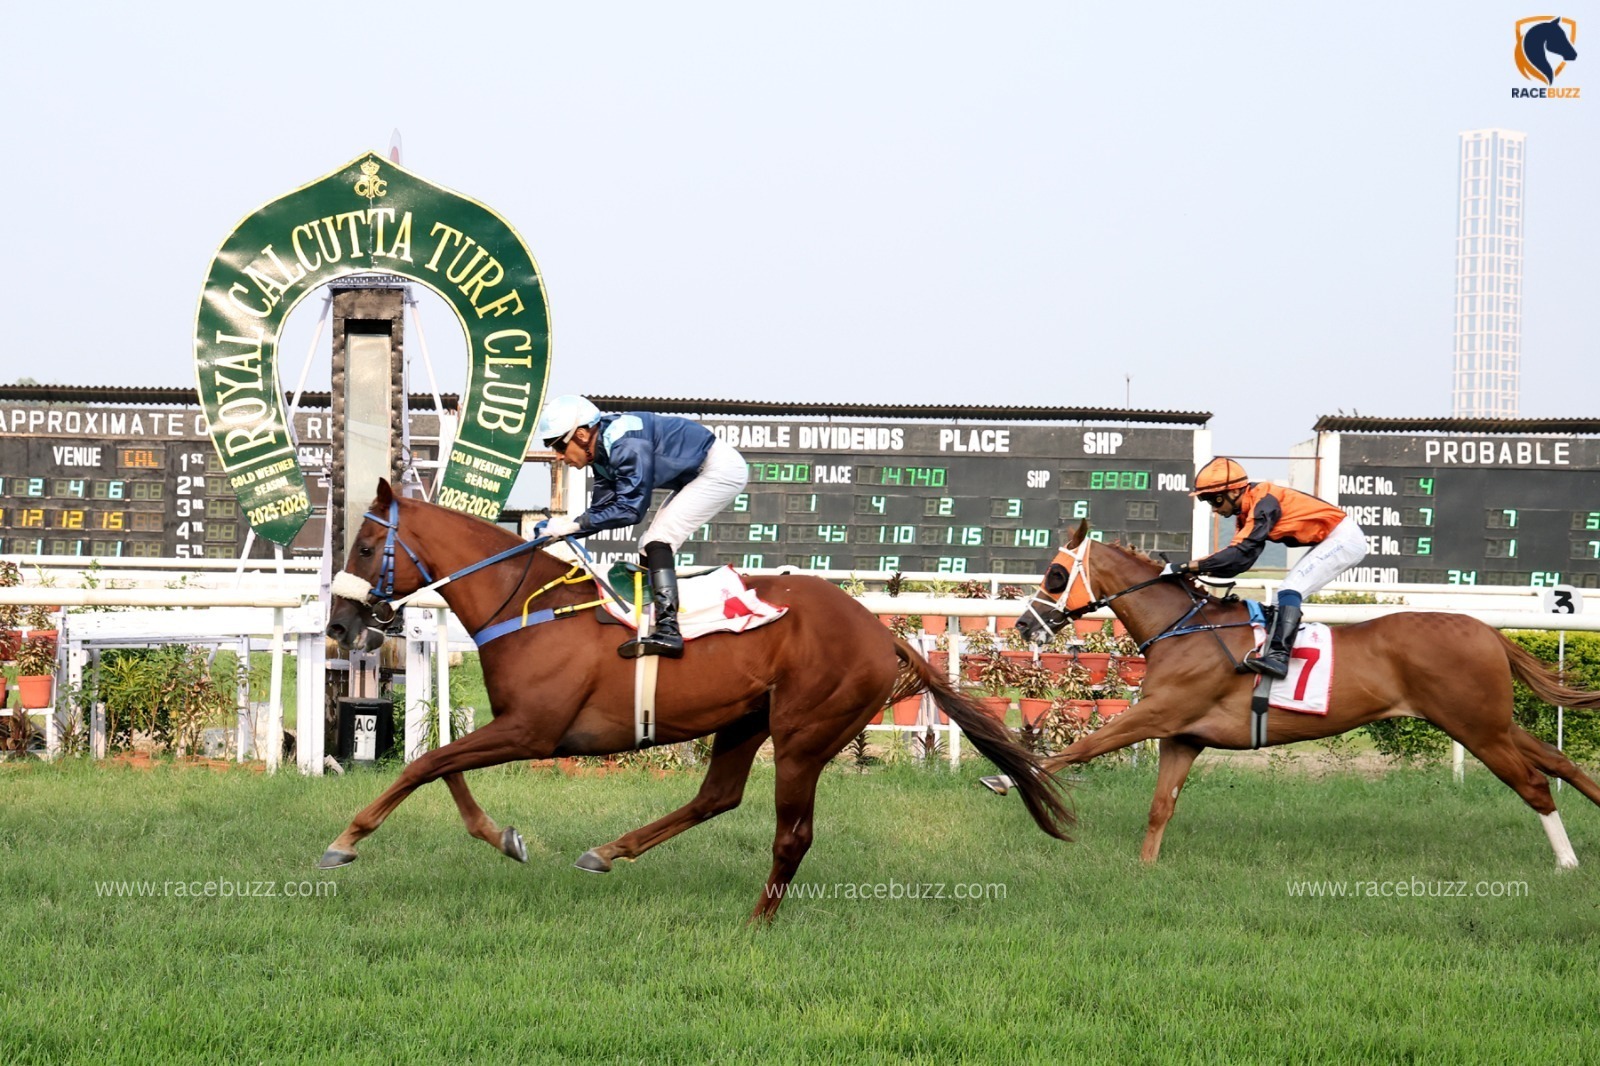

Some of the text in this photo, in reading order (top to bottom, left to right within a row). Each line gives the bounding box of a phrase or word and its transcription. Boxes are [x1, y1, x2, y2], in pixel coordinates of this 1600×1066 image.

[215, 208, 533, 457] ROYAL CALCUTTA TURF CLUB
[0, 409, 184, 436] APPROXIMATE
[702, 425, 1124, 454] OBABLE DIVIDENDS PLACE SHP
[53, 446, 102, 467] VENUE
[124, 450, 159, 467] CAL
[1425, 440, 1570, 465] PROBABLE
[231, 458, 296, 489] COLD WEATHER
[451, 449, 512, 479] COLD WEATHER
[815, 465, 852, 484] PLACE
[254, 476, 289, 497] SEASON
[465, 472, 501, 493] SEASON
[881, 466, 946, 487] 14740
[1027, 470, 1050, 488] SHP
[1157, 473, 1190, 491] POOL
[1339, 475, 1398, 496] RACE No.
[1419, 478, 1433, 495] 4
[28, 478, 124, 499] 2 4 6
[247, 491, 309, 527] 2025-2026
[438, 486, 501, 520] 2025-2026
[734, 494, 749, 512] 5
[872, 496, 886, 514] 4
[938, 497, 954, 515] 2
[1006, 498, 1021, 517] 3
[1073, 500, 1088, 518] 6
[62, 510, 84, 529] 12
[103, 511, 124, 529] 15
[1382, 507, 1402, 526] No.
[1419, 508, 1433, 526] 7
[1503, 509, 1517, 527] 7
[749, 523, 778, 542] 24
[1014, 528, 1049, 546] 140
[1381, 536, 1401, 555] No.
[1417, 537, 1432, 554] 5
[743, 554, 763, 569] 10
[811, 555, 830, 570] 14
[1551, 590, 1575, 614] 3
[1290, 647, 1320, 701] 7
